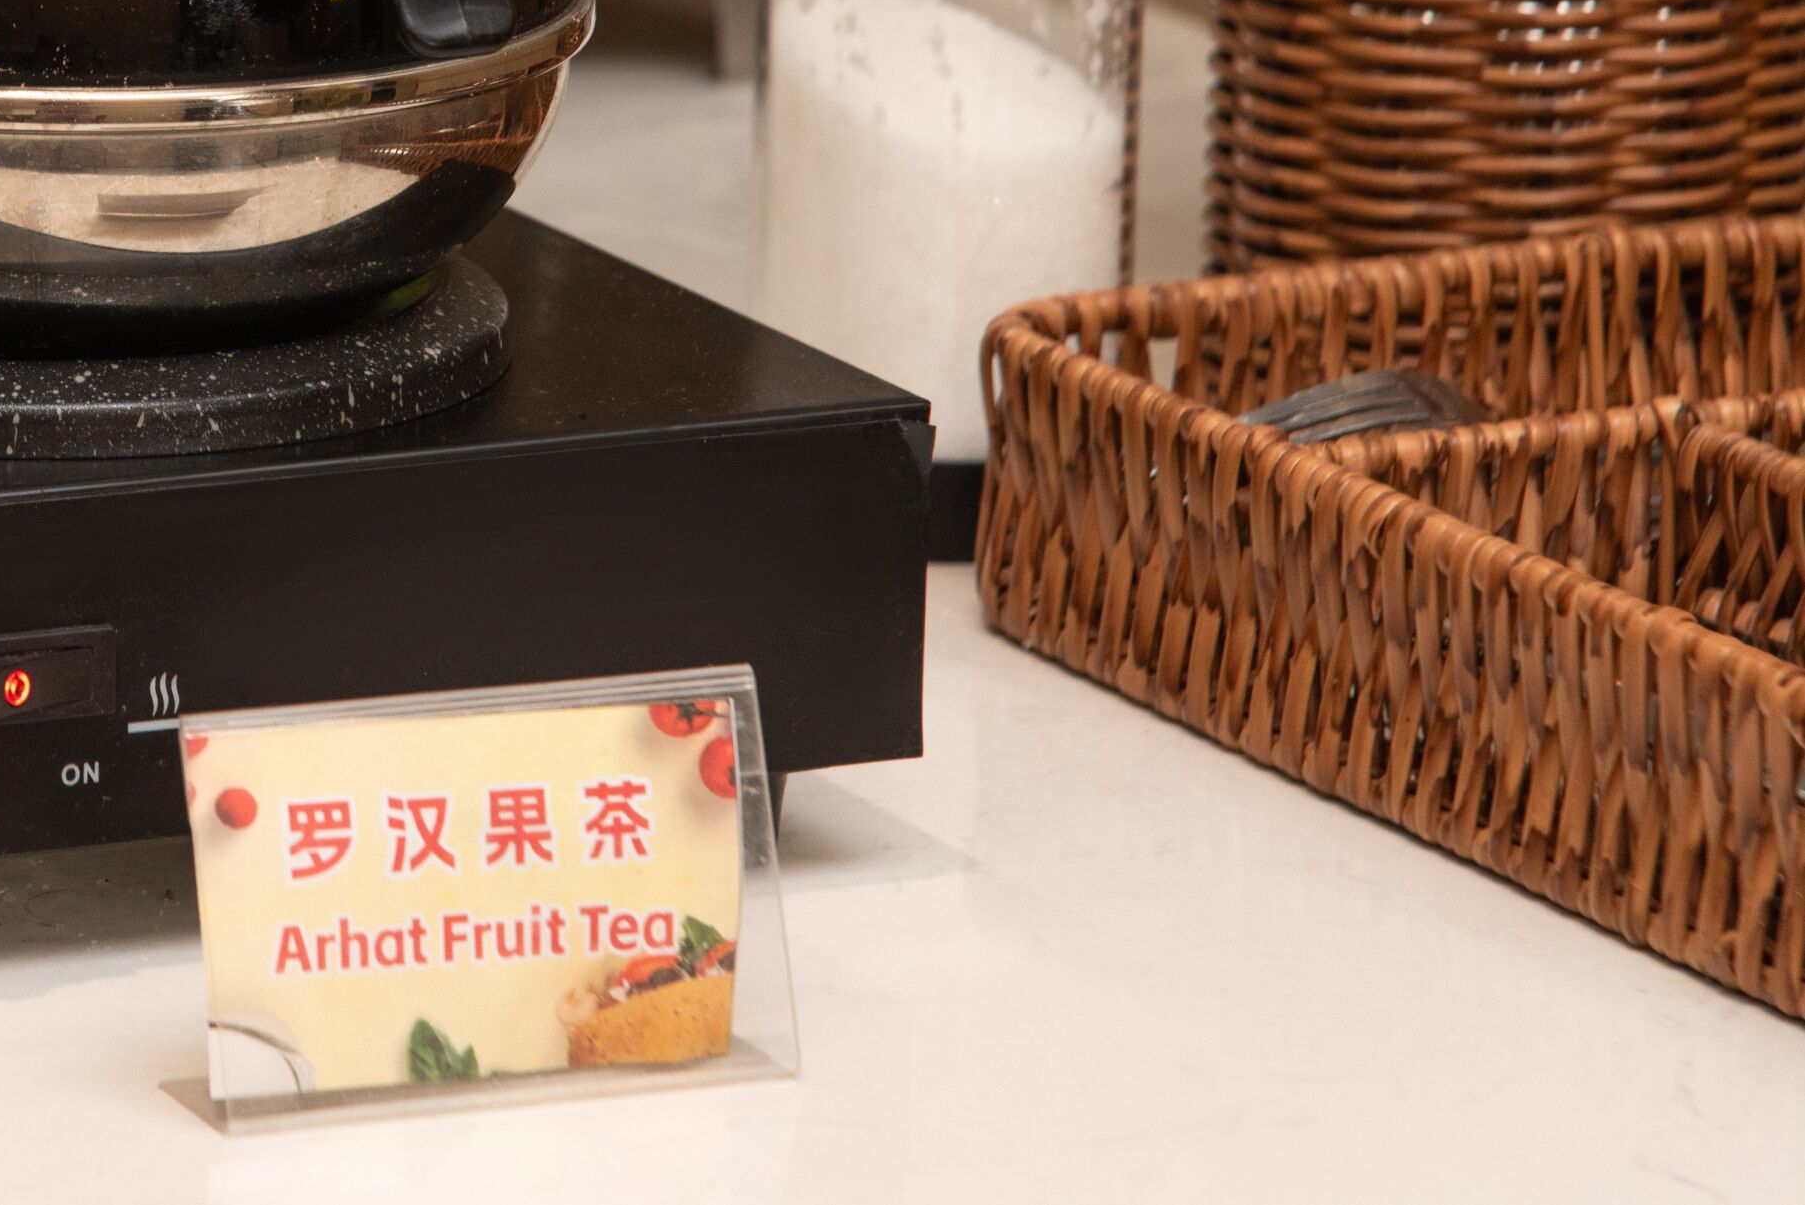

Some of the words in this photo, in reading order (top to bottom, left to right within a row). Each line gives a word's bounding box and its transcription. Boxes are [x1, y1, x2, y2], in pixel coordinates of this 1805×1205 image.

[61, 761, 100, 786] ON
[287, 781, 649, 879] 罗汉果茶
[275, 916, 428, 975] Arhat
[442, 904, 566, 963] Fruit
[579, 906, 676, 953] Tea
